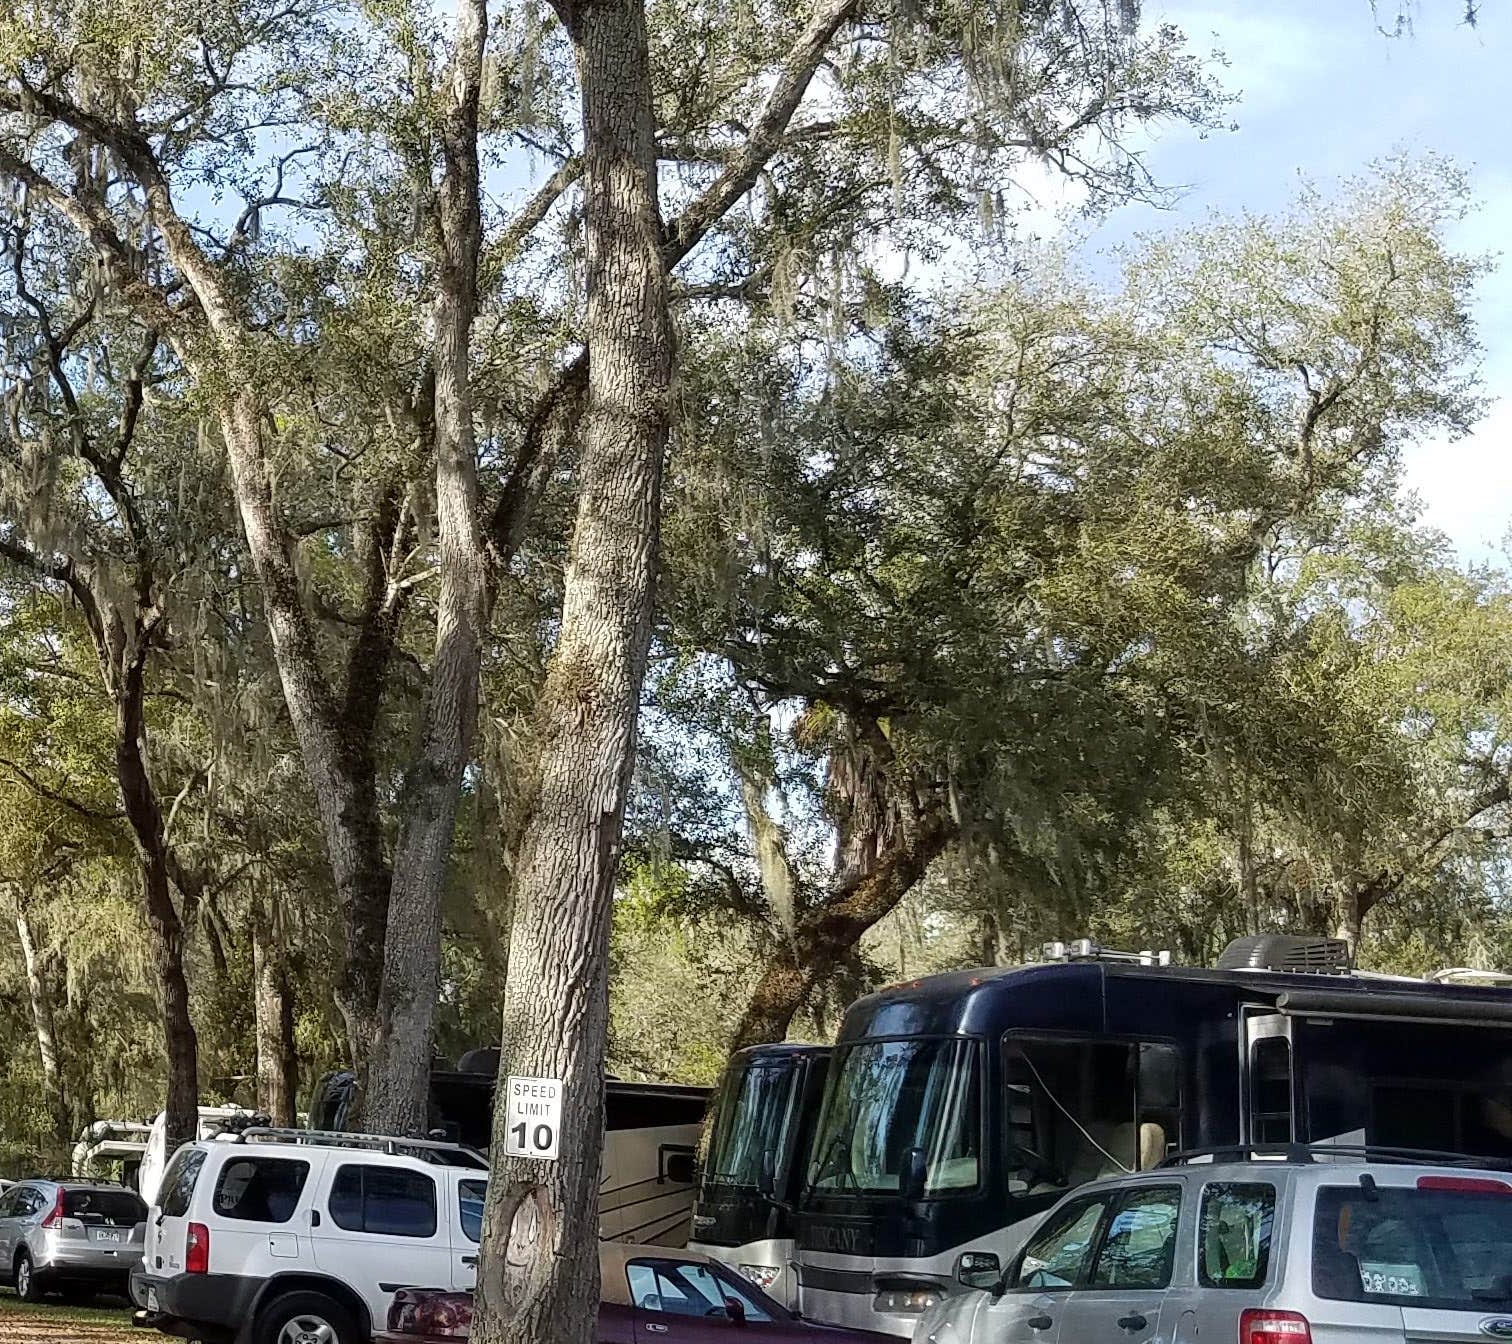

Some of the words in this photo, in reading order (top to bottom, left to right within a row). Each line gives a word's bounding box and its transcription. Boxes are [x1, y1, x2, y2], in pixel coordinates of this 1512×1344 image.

[513, 1083, 556, 1098] SPEED
[517, 1102, 551, 1116] LIMIT
[511, 1122, 553, 1151] 10
